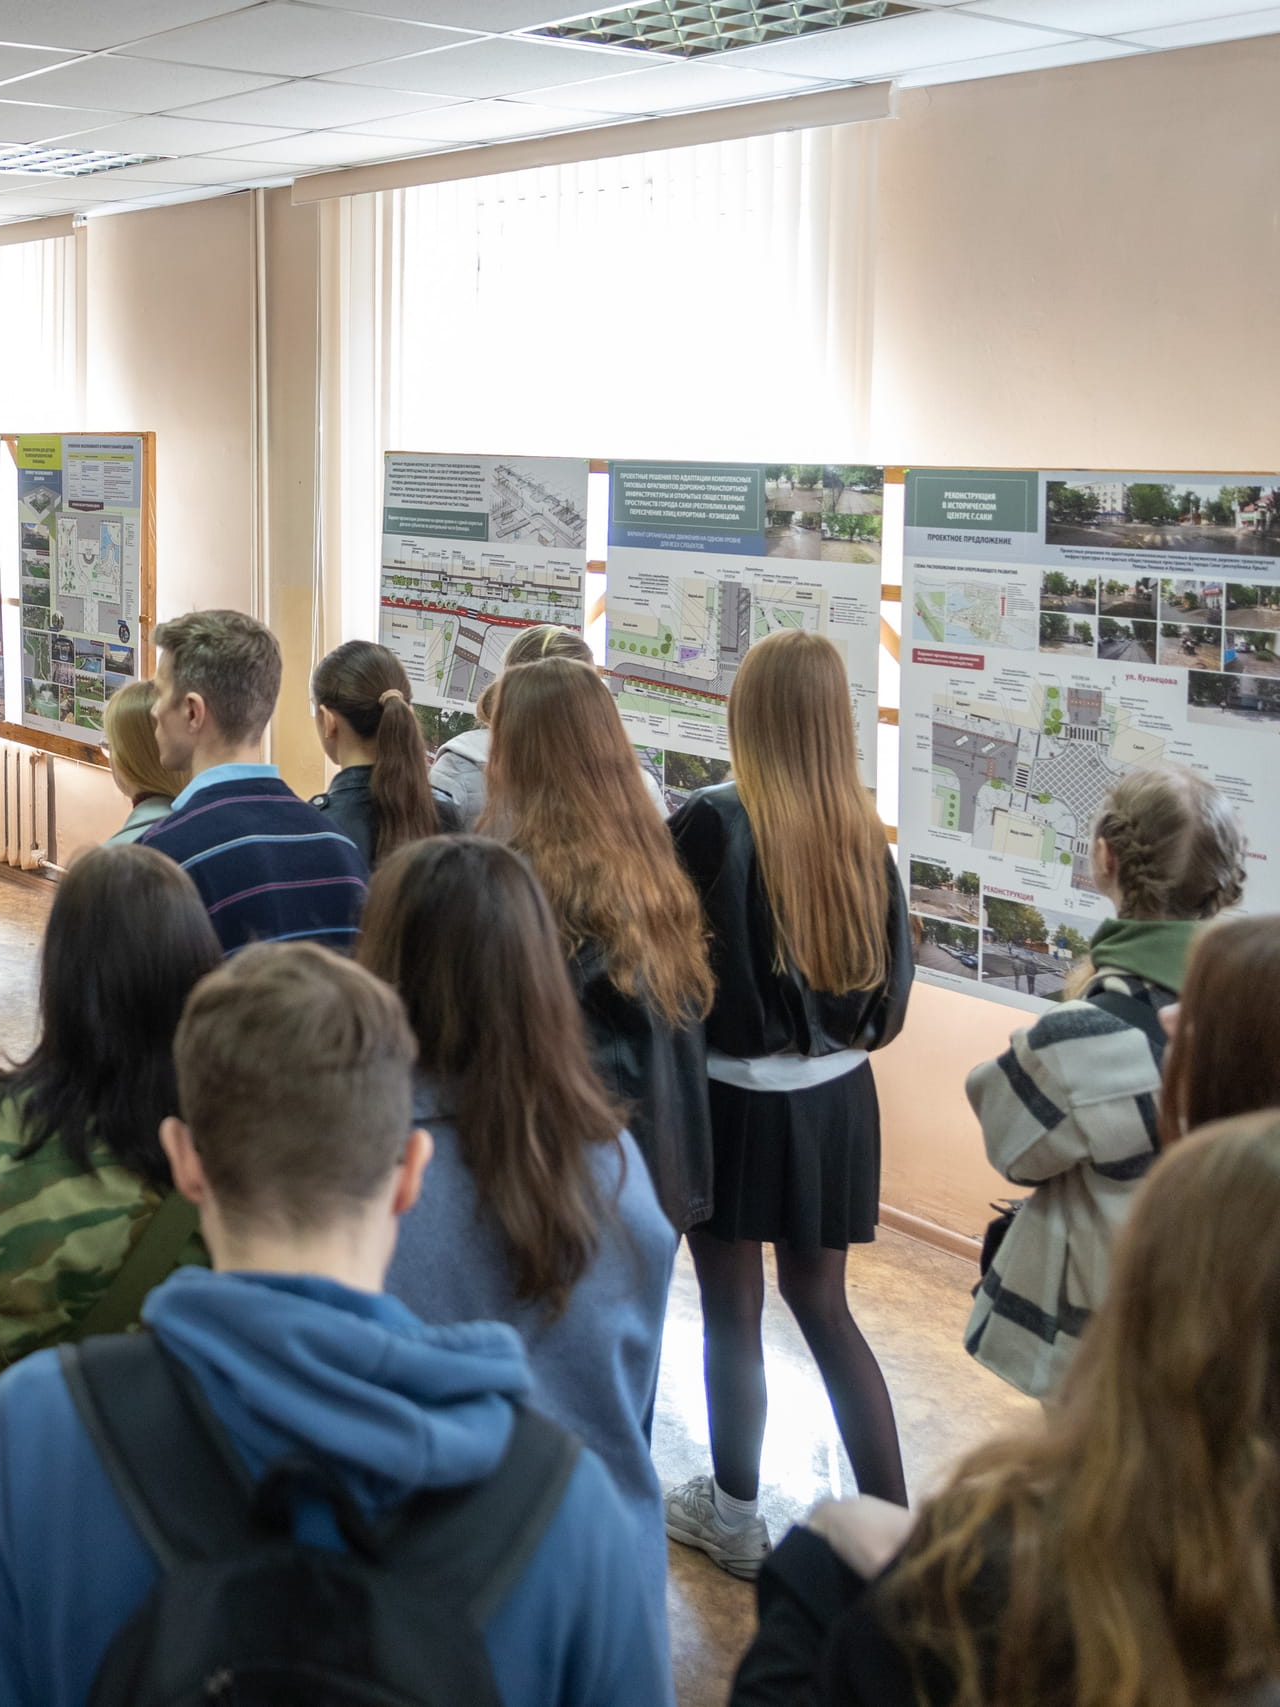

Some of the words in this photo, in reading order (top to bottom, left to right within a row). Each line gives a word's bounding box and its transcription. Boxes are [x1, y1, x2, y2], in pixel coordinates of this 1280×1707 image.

[944, 492, 996, 500] РЕКОНСТРУКЦИЯ
[948, 502, 996, 510] ИСТОРИЧЕСКОМ
[663, 510, 676, 518] УЛИЦ
[677, 511, 705, 519] КУРОРТНАЯ
[947, 512, 970, 520] ЦЕНТРЕ
[928, 534, 962, 542] ПРОЕКТНОЕ
[964, 535, 1011, 545] ПРЕДЛОЖЕНИЕ
[1125, 673, 1136, 681] ул.
[1138, 674, 1178, 685] Кузнецова
[984, 885, 1034, 902] РЕКОНСТРУКЦИЯ
